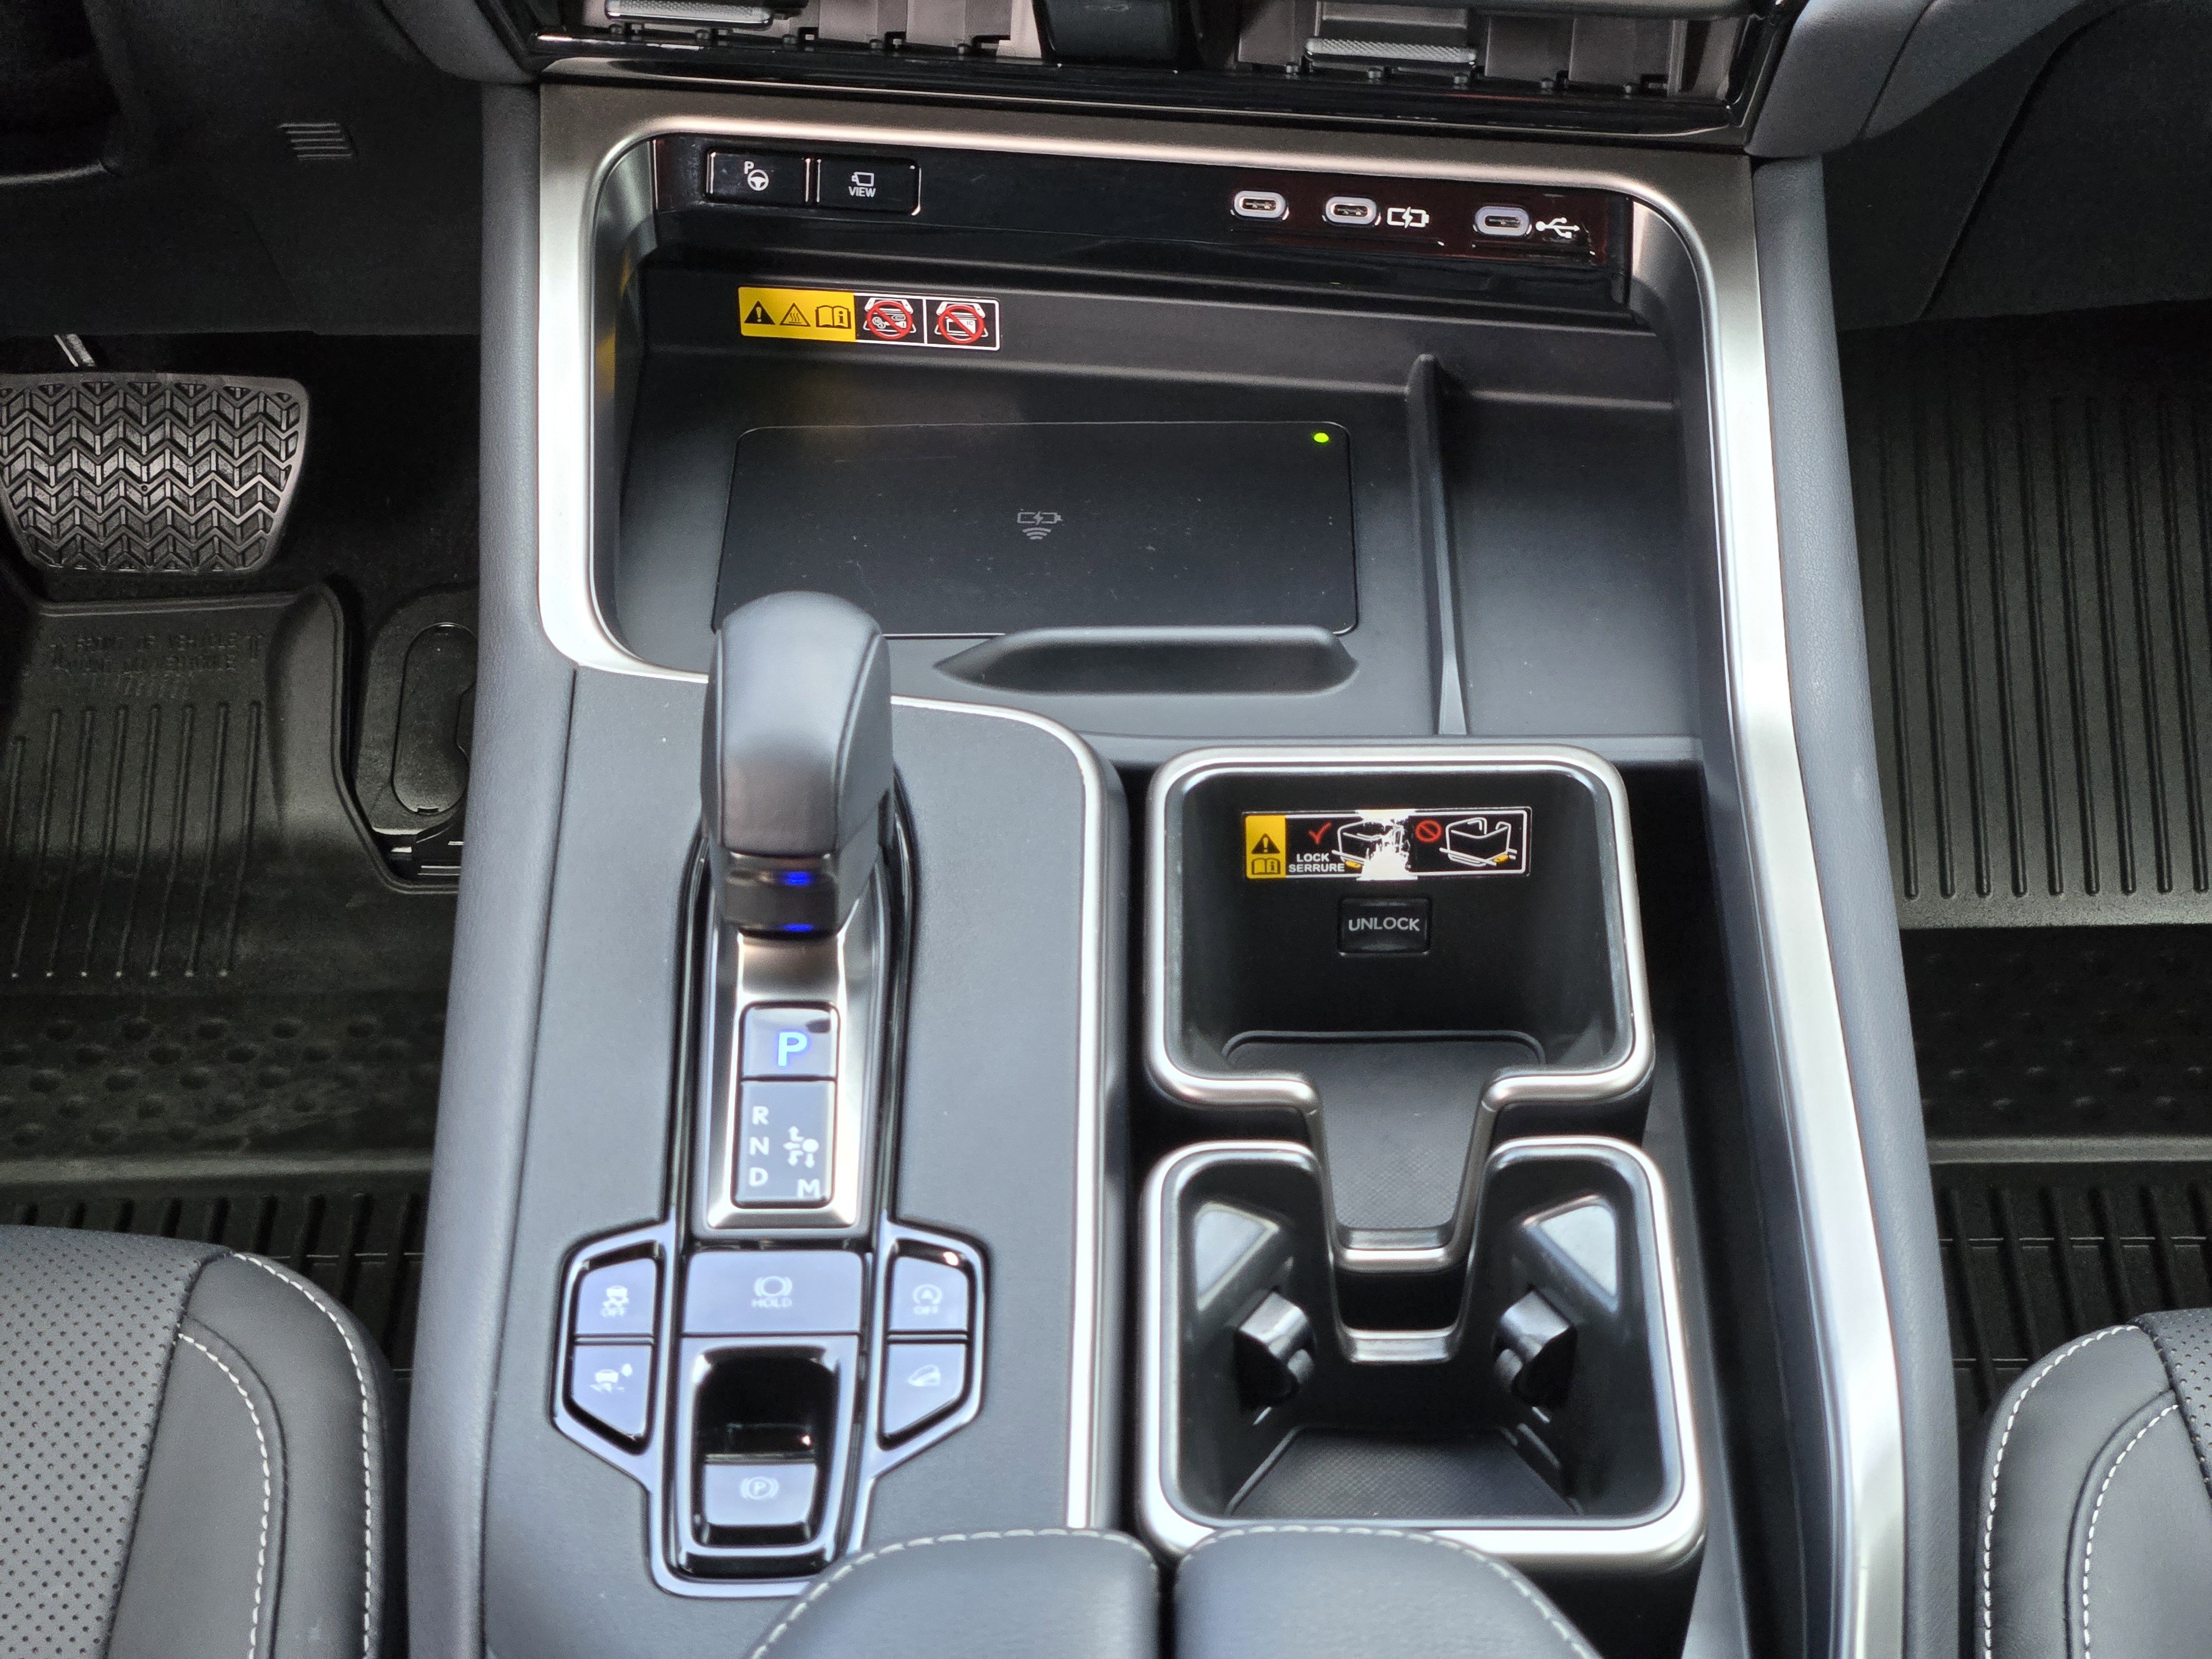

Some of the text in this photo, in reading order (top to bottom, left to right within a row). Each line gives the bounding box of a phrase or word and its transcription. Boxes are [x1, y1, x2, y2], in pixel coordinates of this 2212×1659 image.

[848, 186, 876, 197] VIEW
[1296, 853, 1329, 862] LOCK
[1288, 863, 1345, 873] SERRURE
[1348, 917, 1420, 931] UNLOCK
[778, 1031, 808, 1067] P
[752, 1105, 769, 1125] R
[749, 1136, 769, 1155] N
[749, 1167, 768, 1186] D
[797, 1178, 820, 1198] M
[751, 1297, 793, 1308] HOLD
[601, 1307, 626, 1318] OFF
